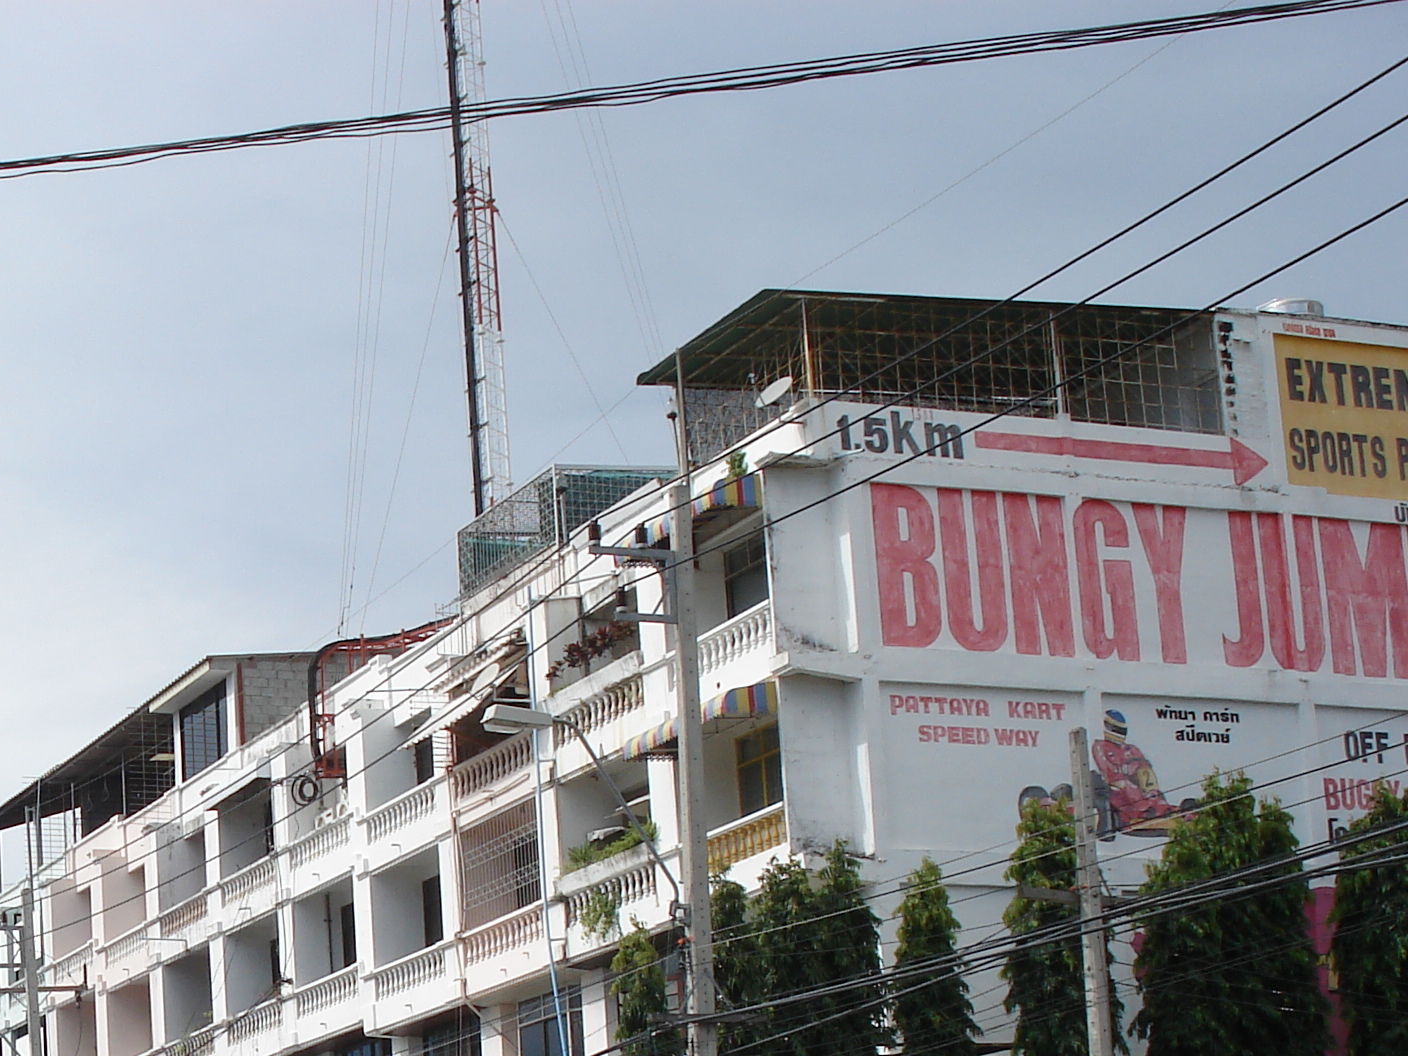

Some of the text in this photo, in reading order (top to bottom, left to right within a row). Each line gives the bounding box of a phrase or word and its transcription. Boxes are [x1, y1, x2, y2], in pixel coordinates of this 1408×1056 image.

[836, 410, 964, 460] 1.5km
[1289, 427, 1387, 479] SPORTS
[870, 482, 1408, 679] BUNGY JUM
[889, 694, 1065, 721] PATTAYA KART
[1155, 704, 1196, 721] พัทยา
[1343, 730, 1389, 764] OFF
[1323, 777, 1401, 811] BUGY
